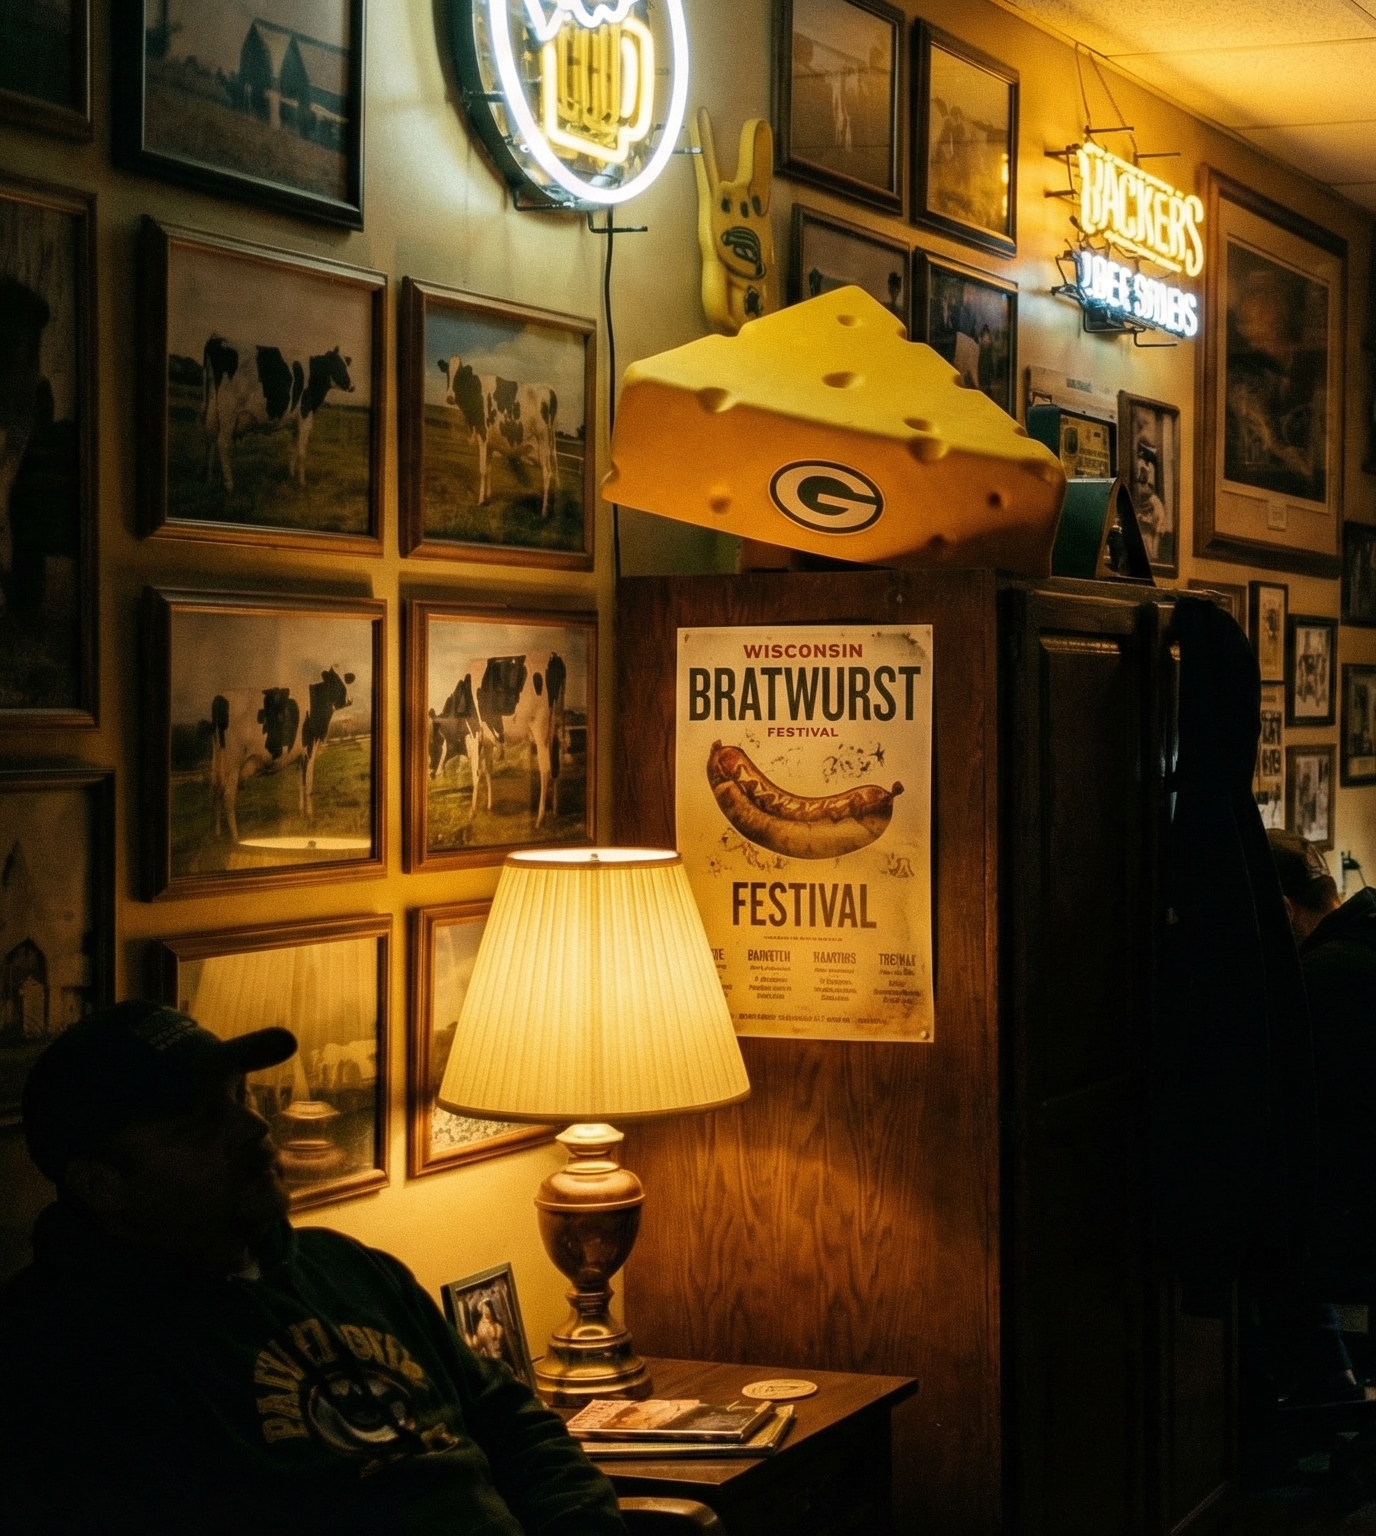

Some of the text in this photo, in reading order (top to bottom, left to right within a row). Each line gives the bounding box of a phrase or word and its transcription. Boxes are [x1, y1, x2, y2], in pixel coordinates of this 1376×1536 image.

[775, 465, 877, 529] G
[742, 643, 864, 659] WISCONSIN
[688, 665, 922, 722] BRATWURST
[766, 727, 839, 738] FESTIVAL
[731, 881, 878, 930] FESTIVAL
